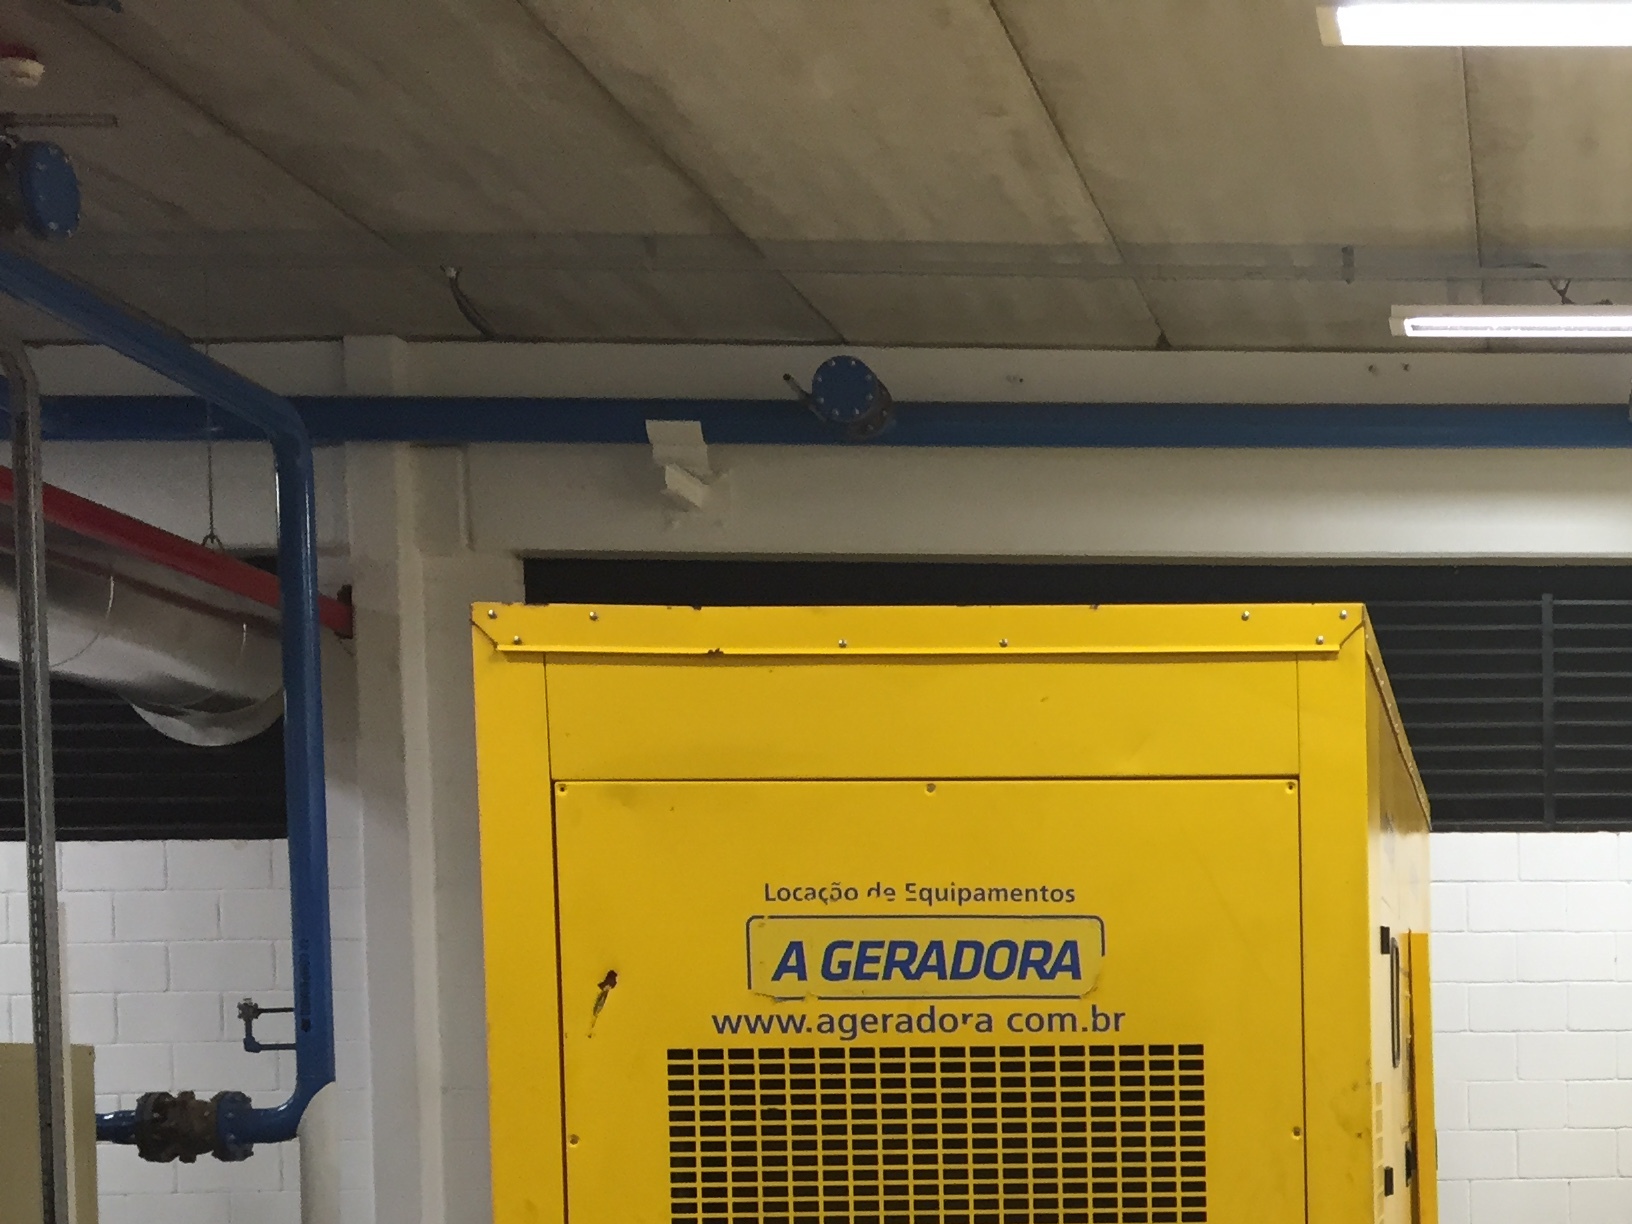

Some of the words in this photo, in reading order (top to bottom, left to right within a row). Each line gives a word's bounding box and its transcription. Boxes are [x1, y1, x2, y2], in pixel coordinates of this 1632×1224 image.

[764, 882, 859, 905] Locação
[867, 881, 896, 902] de
[905, 883, 1075, 906] Equipamentos
[771, 940, 808, 981] A
[820, 940, 1082, 981] GERADORA
